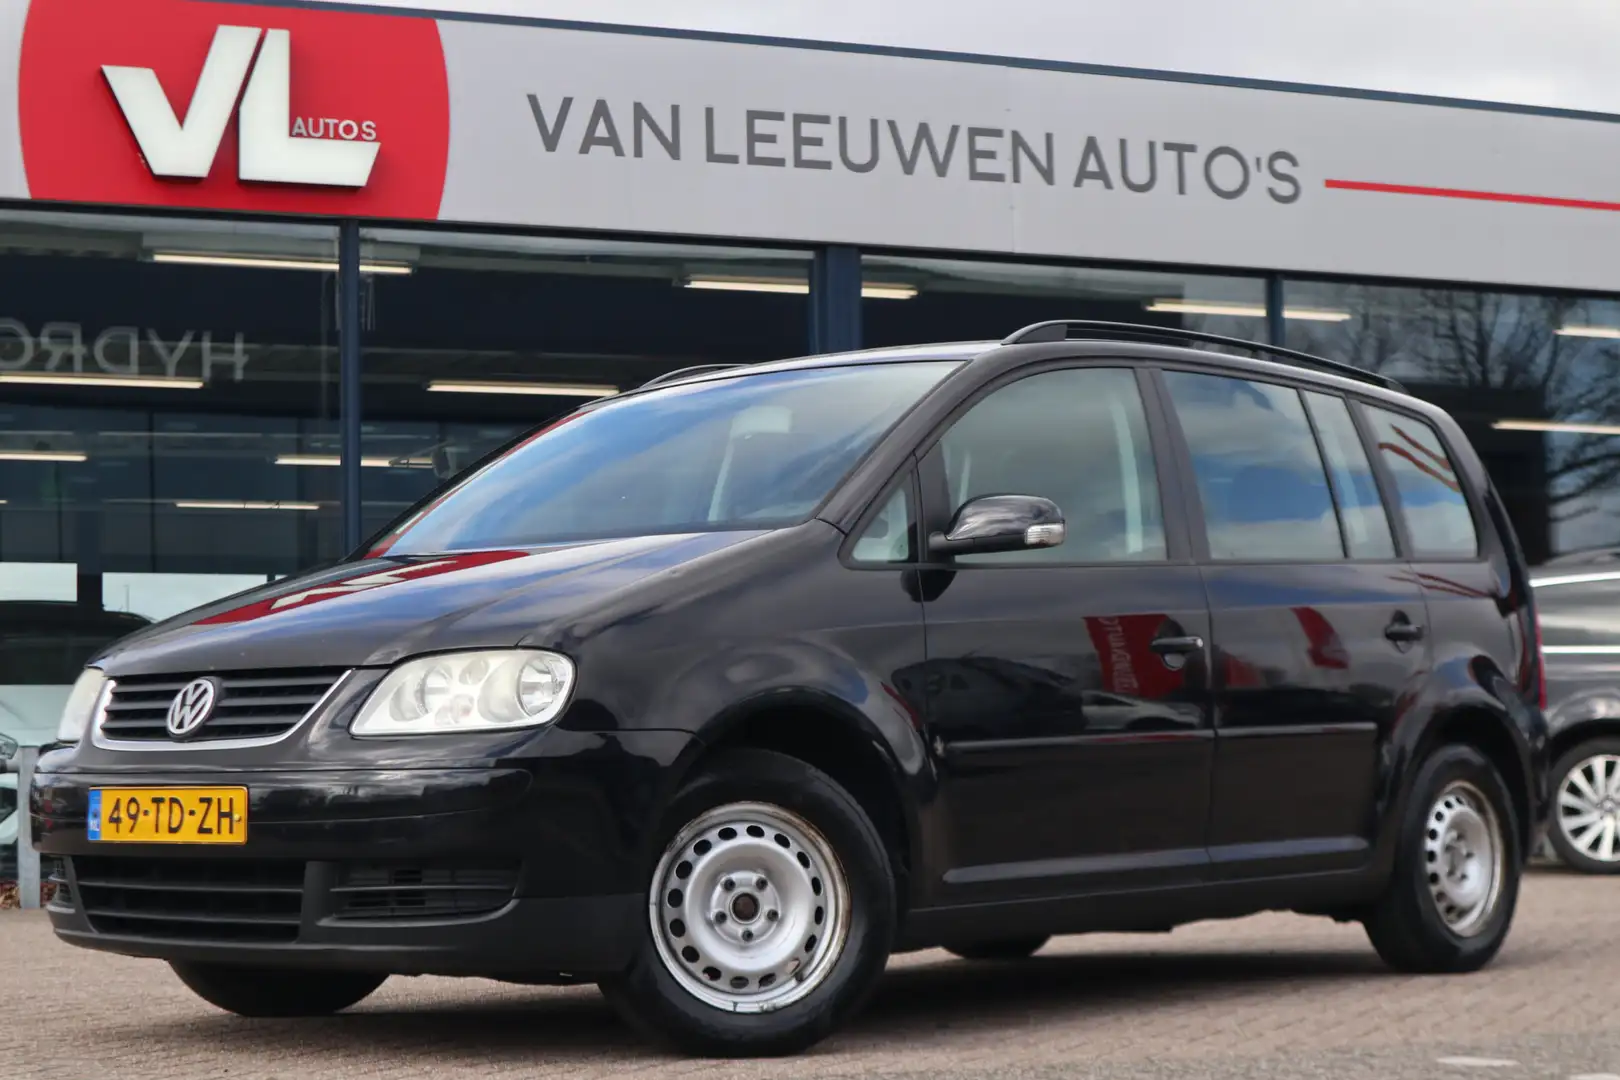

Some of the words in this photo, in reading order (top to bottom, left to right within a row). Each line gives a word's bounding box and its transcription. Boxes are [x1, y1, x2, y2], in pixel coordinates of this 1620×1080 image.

[101, 25, 381, 187] VL
[291, 116, 377, 141] AUTOS
[526, 93, 681, 161] VAN
[704, 106, 1055, 186] LEEUWEN
[1073, 135, 1301, 204] AUTO'S
[108, 797, 234, 835] 49-TD-ZH
